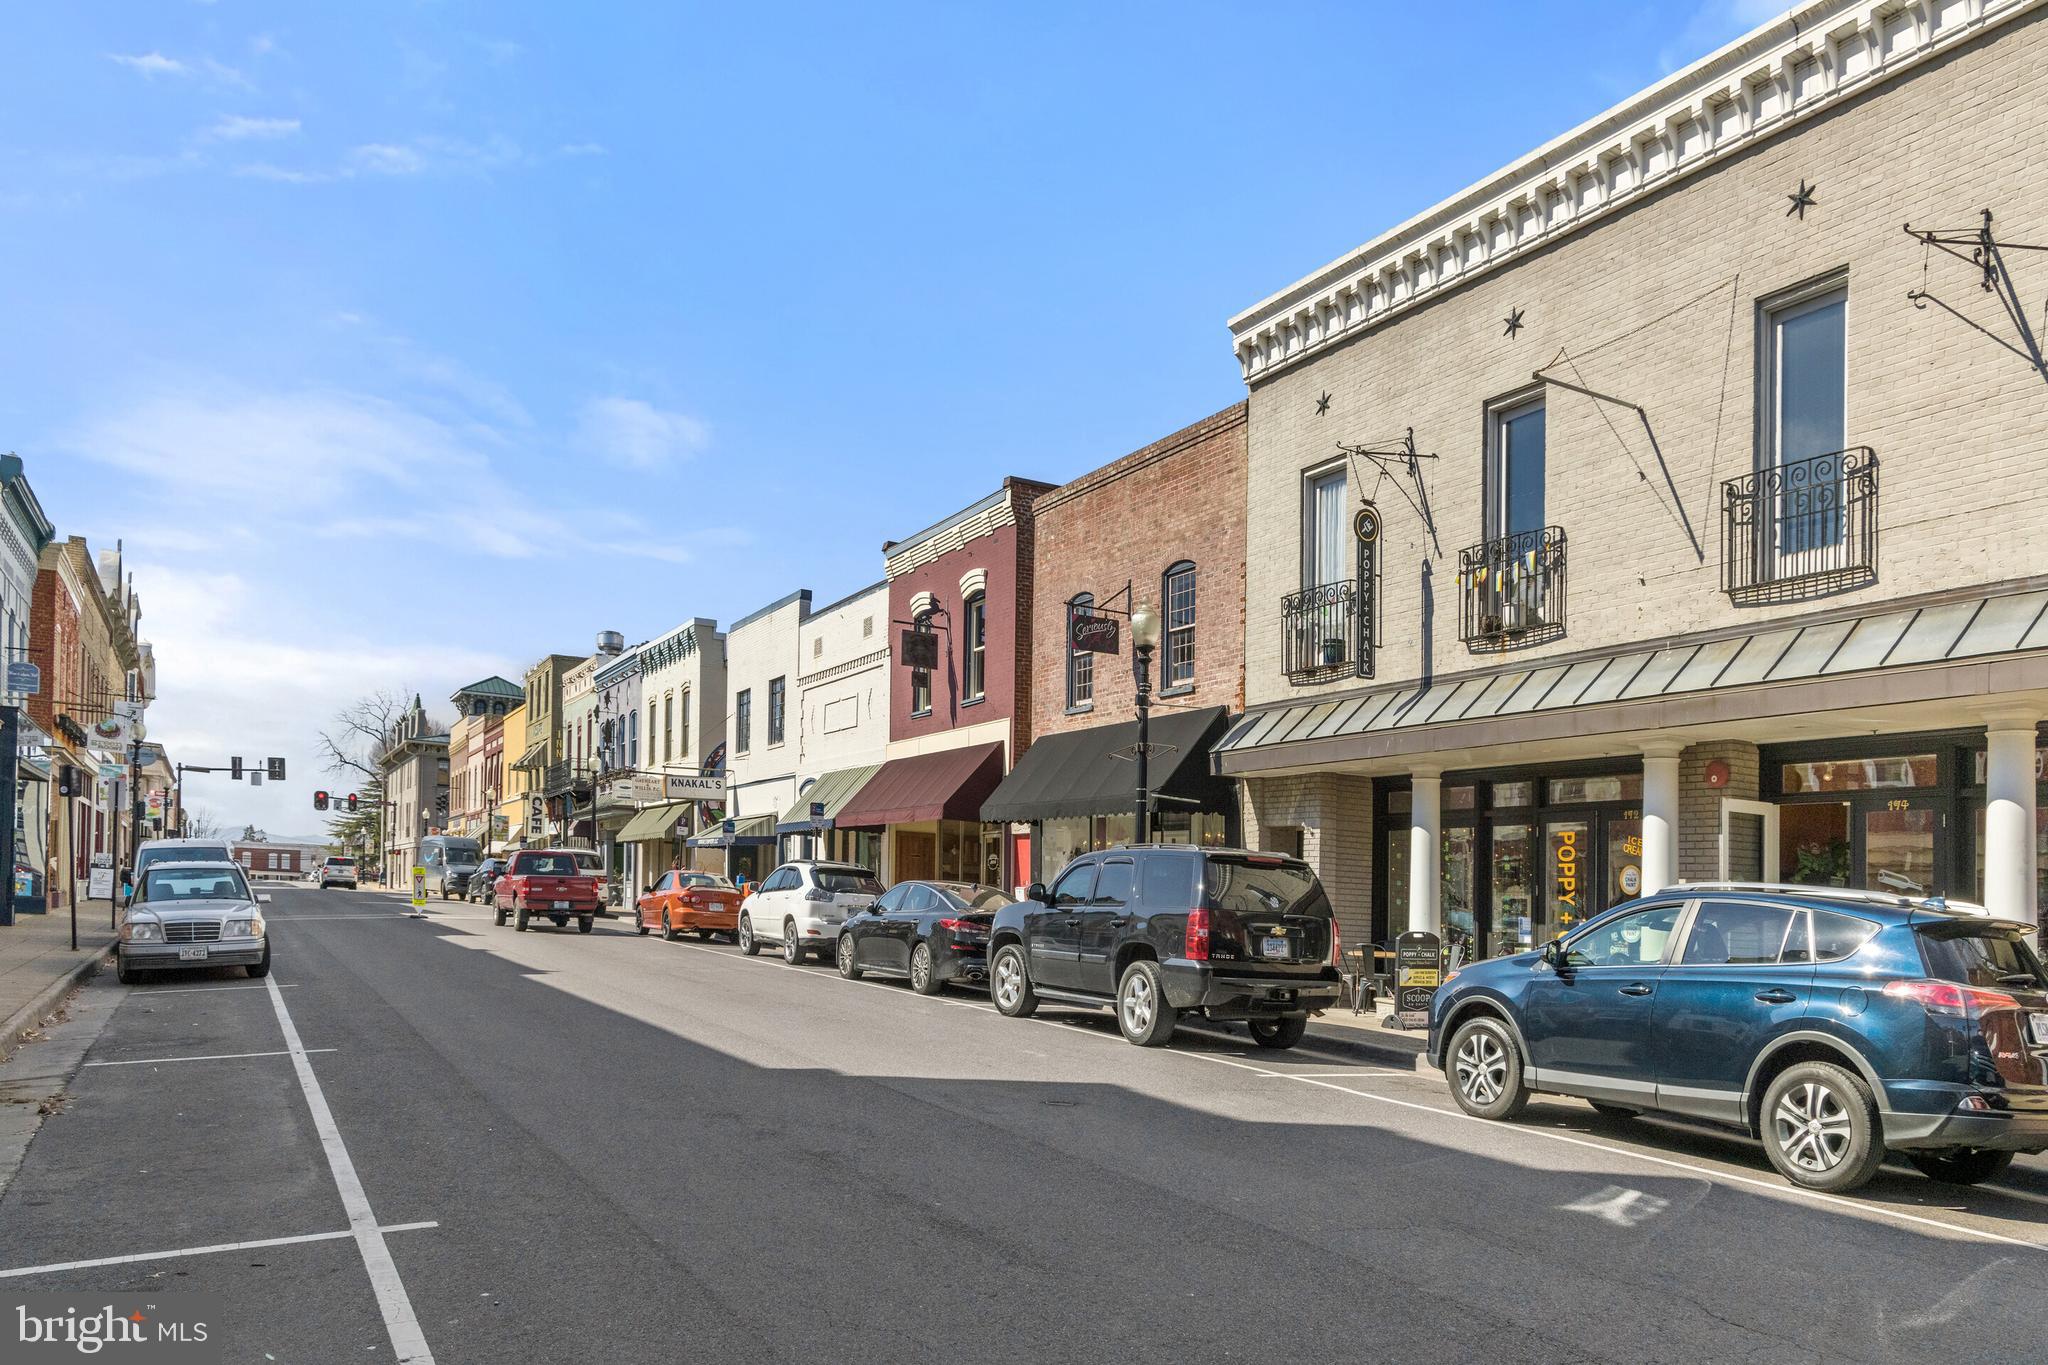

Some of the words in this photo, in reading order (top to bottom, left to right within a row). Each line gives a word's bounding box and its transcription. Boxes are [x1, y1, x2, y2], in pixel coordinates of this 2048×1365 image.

[1075, 620, 1117, 641] Seriously
[671, 778, 722, 790] KNAKAL'S
[531, 796, 543, 834] CAFE
[1627, 835, 1643, 847] ICE
[1623, 843, 1643, 857] CREA
[1558, 831, 1576, 906] POPPY
[1406, 994, 1431, 1002] SCOOP
